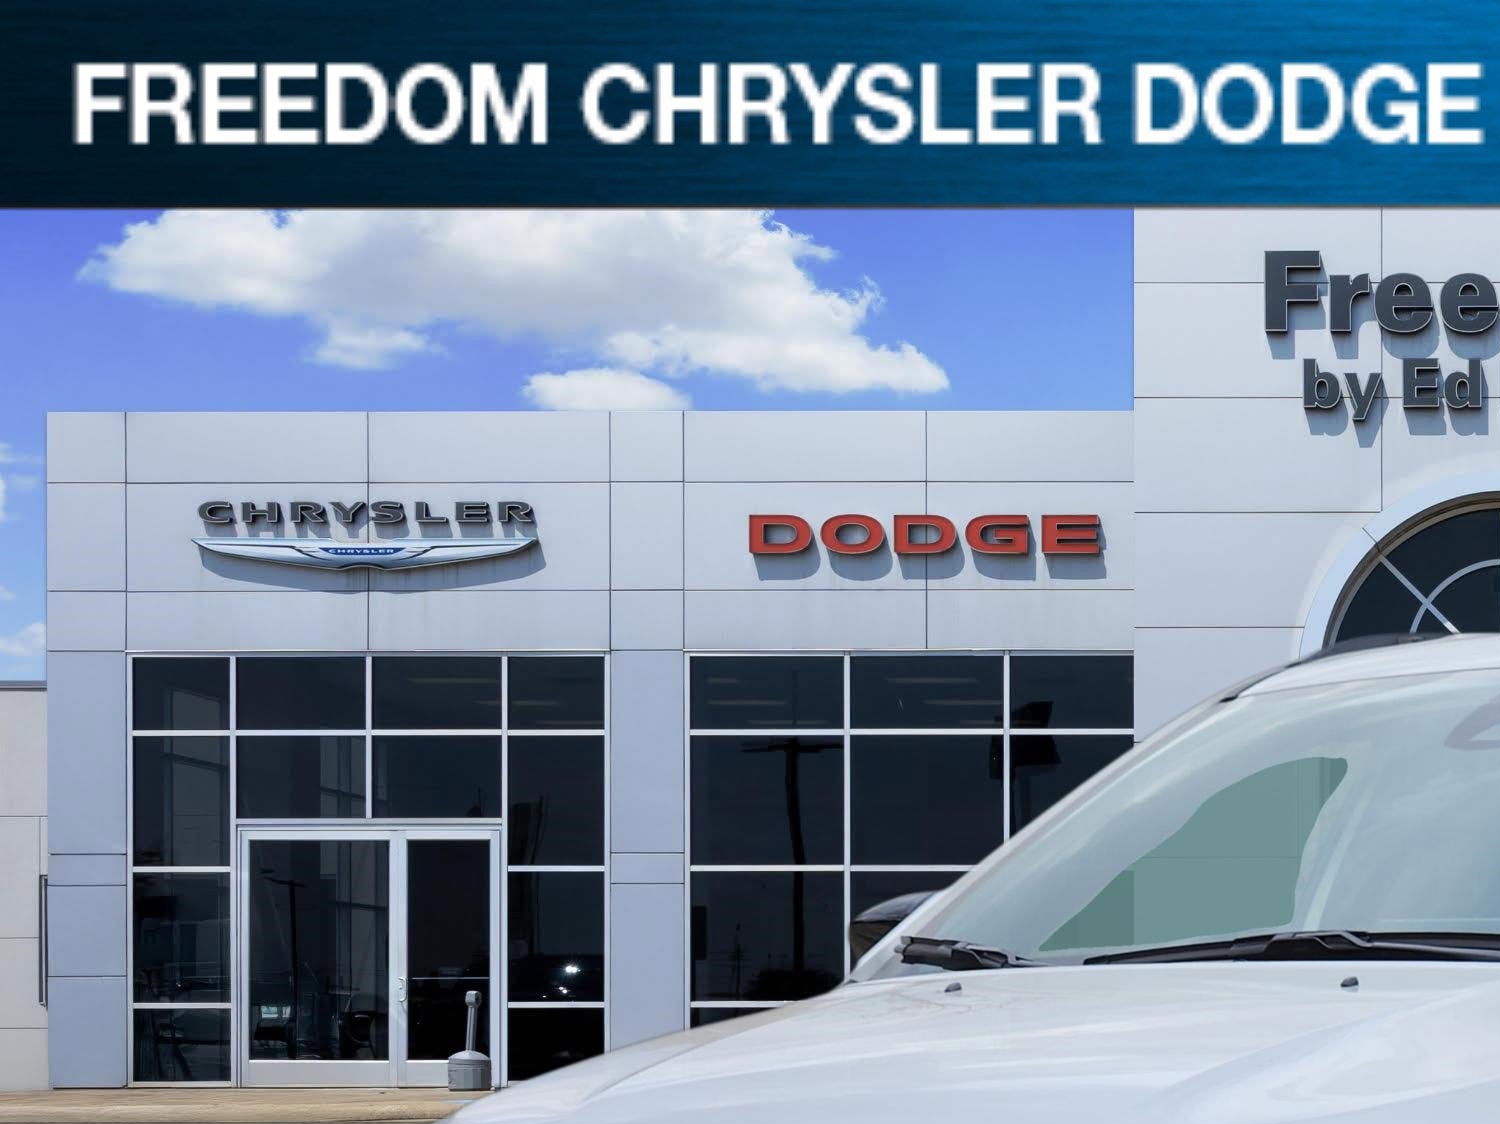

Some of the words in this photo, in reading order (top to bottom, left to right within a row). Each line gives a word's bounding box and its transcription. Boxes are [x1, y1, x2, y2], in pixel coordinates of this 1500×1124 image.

[1303, 358, 1382, 421] by
[1402, 358, 1483, 408] Ed
[198, 500, 536, 525] CHRYSLER
[748, 513, 1102, 555] DODGE
